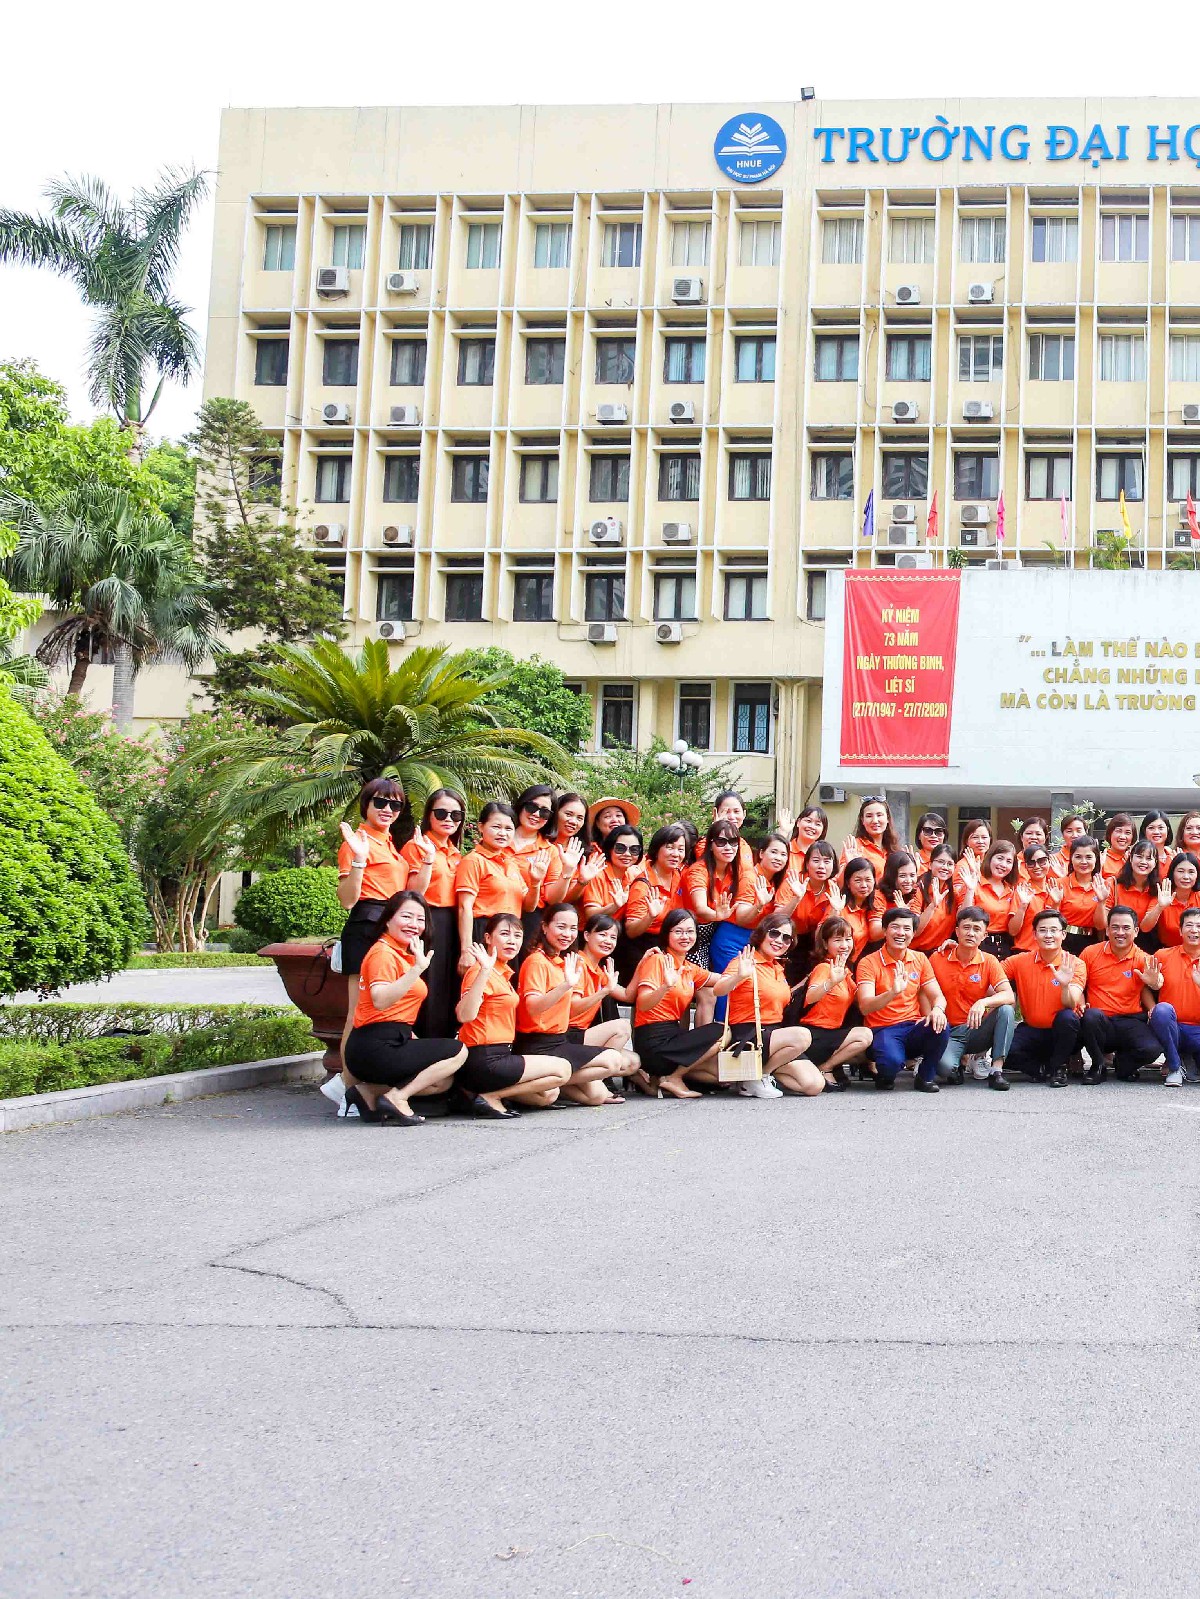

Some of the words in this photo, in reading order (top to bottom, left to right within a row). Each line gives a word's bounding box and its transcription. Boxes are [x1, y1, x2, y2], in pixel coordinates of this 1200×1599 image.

[814, 115, 1030, 162] TRƯỜNG
[1045, 124, 1129, 168] ĐẠI
[736, 160, 762, 168] HNUE
[895, 606, 920, 627] NIỆM
[883, 632, 895, 646] 73
[897, 629, 919, 647] NĂM
[1051, 635, 1093, 658] LÀM
[1145, 636, 1188, 659] NÀO
[857, 652, 880, 670] NGÀY
[1117, 664, 1188, 685] NHỮNG
[885, 675, 903, 696] LIỆT
[905, 675, 916, 693] SĨ
[1001, 688, 1031, 709] MÀ
[1037, 688, 1077, 710] CÒN
[1084, 689, 1111, 711] LÀ
[1116, 689, 1196, 711] TRƯỜNG
